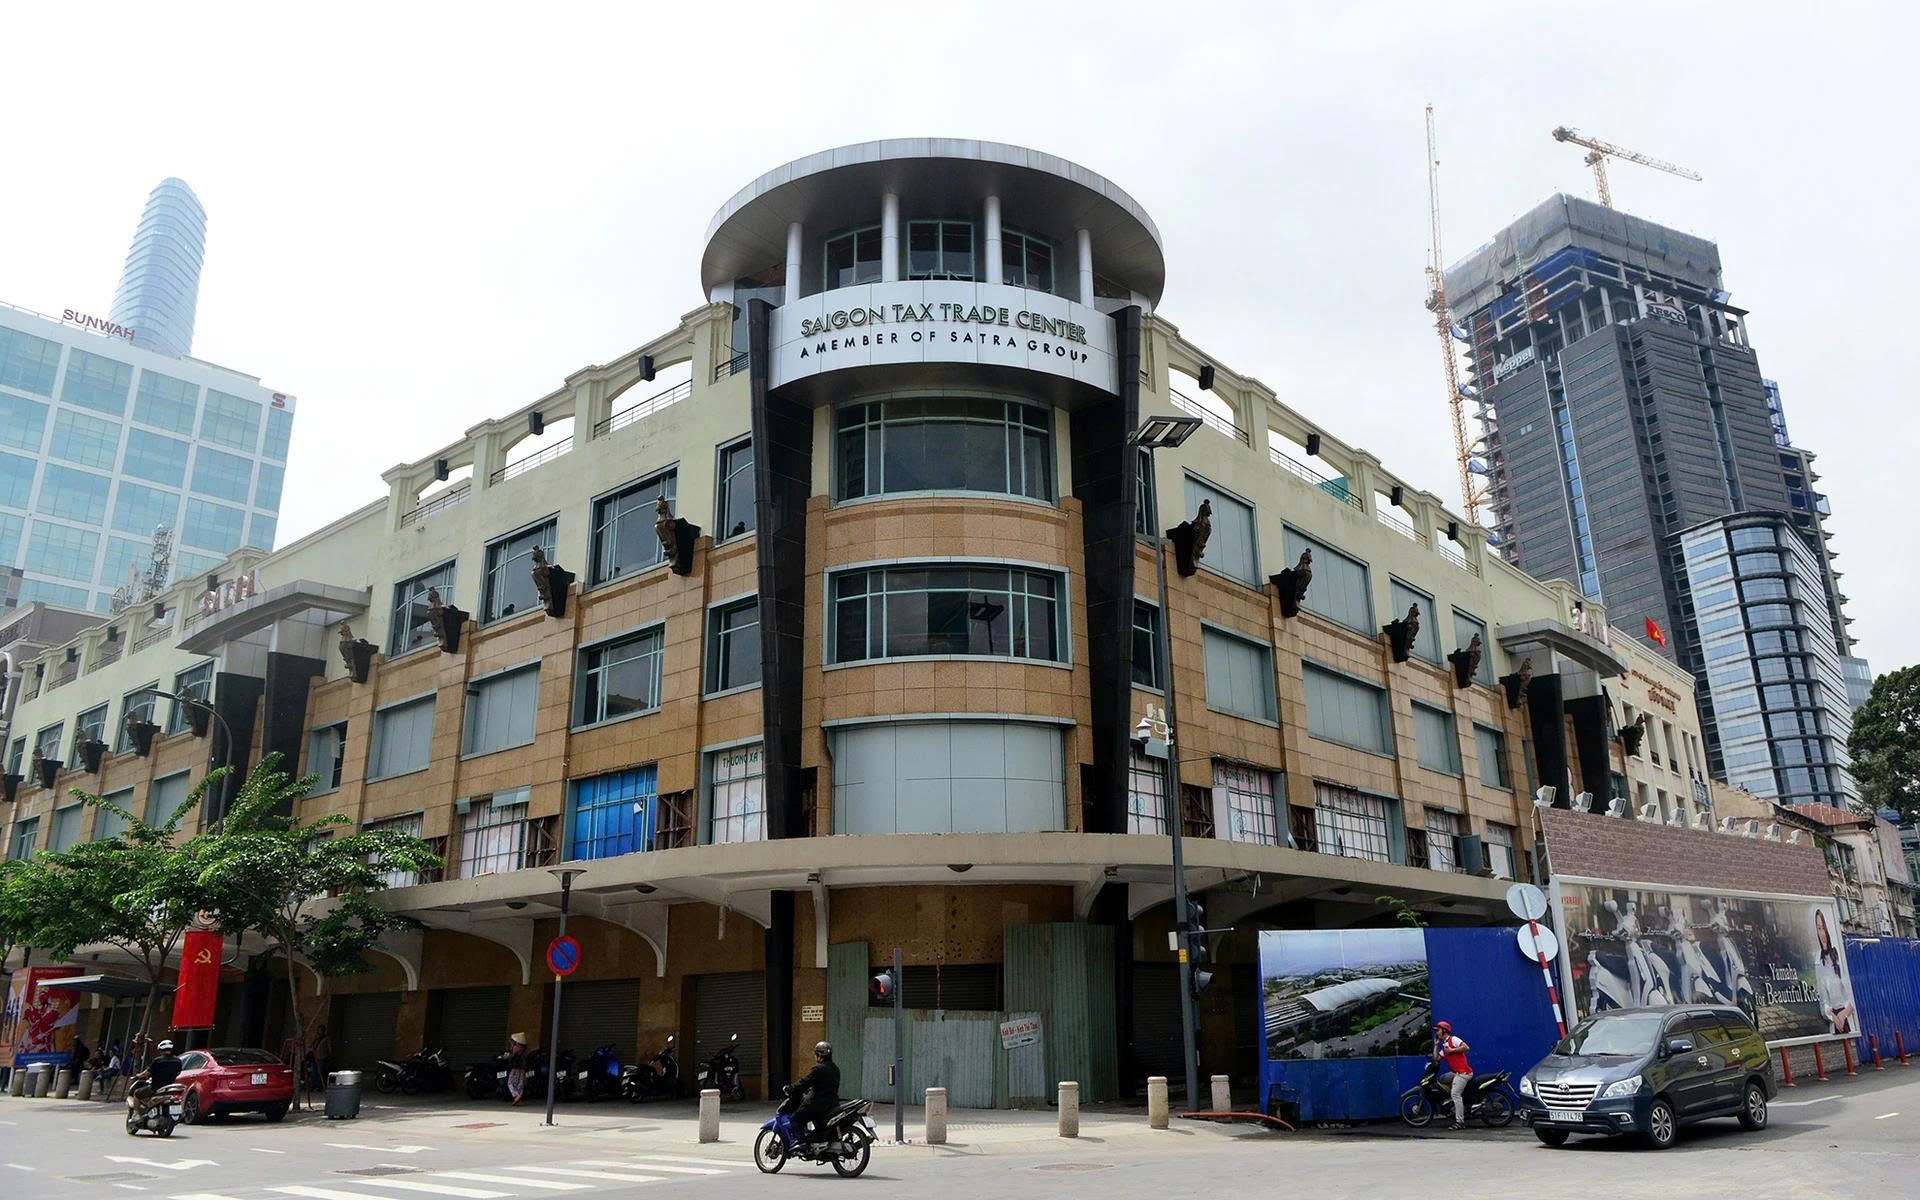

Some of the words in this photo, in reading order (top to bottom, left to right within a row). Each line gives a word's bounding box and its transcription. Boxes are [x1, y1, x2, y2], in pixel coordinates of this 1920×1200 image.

[63, 308, 136, 341] SUNWAH
[801, 306, 884, 337] SAIGON
[892, 303, 934, 322] TAX
[940, 303, 1010, 326] TRADE
[1015, 310, 1088, 345] CENTER
[801, 347, 809, 359] A
[815, 332, 898, 354] MEMBER
[910, 331, 936, 342] OF
[951, 331, 1017, 348] SATRA
[1028, 340, 1088, 363] GROUP
[1494, 348, 1532, 377] Keppel
[1768, 963, 1798, 980] Yamaha
[1755, 992, 1766, 1006] for
[1764, 982, 1803, 1005] Beautiful
